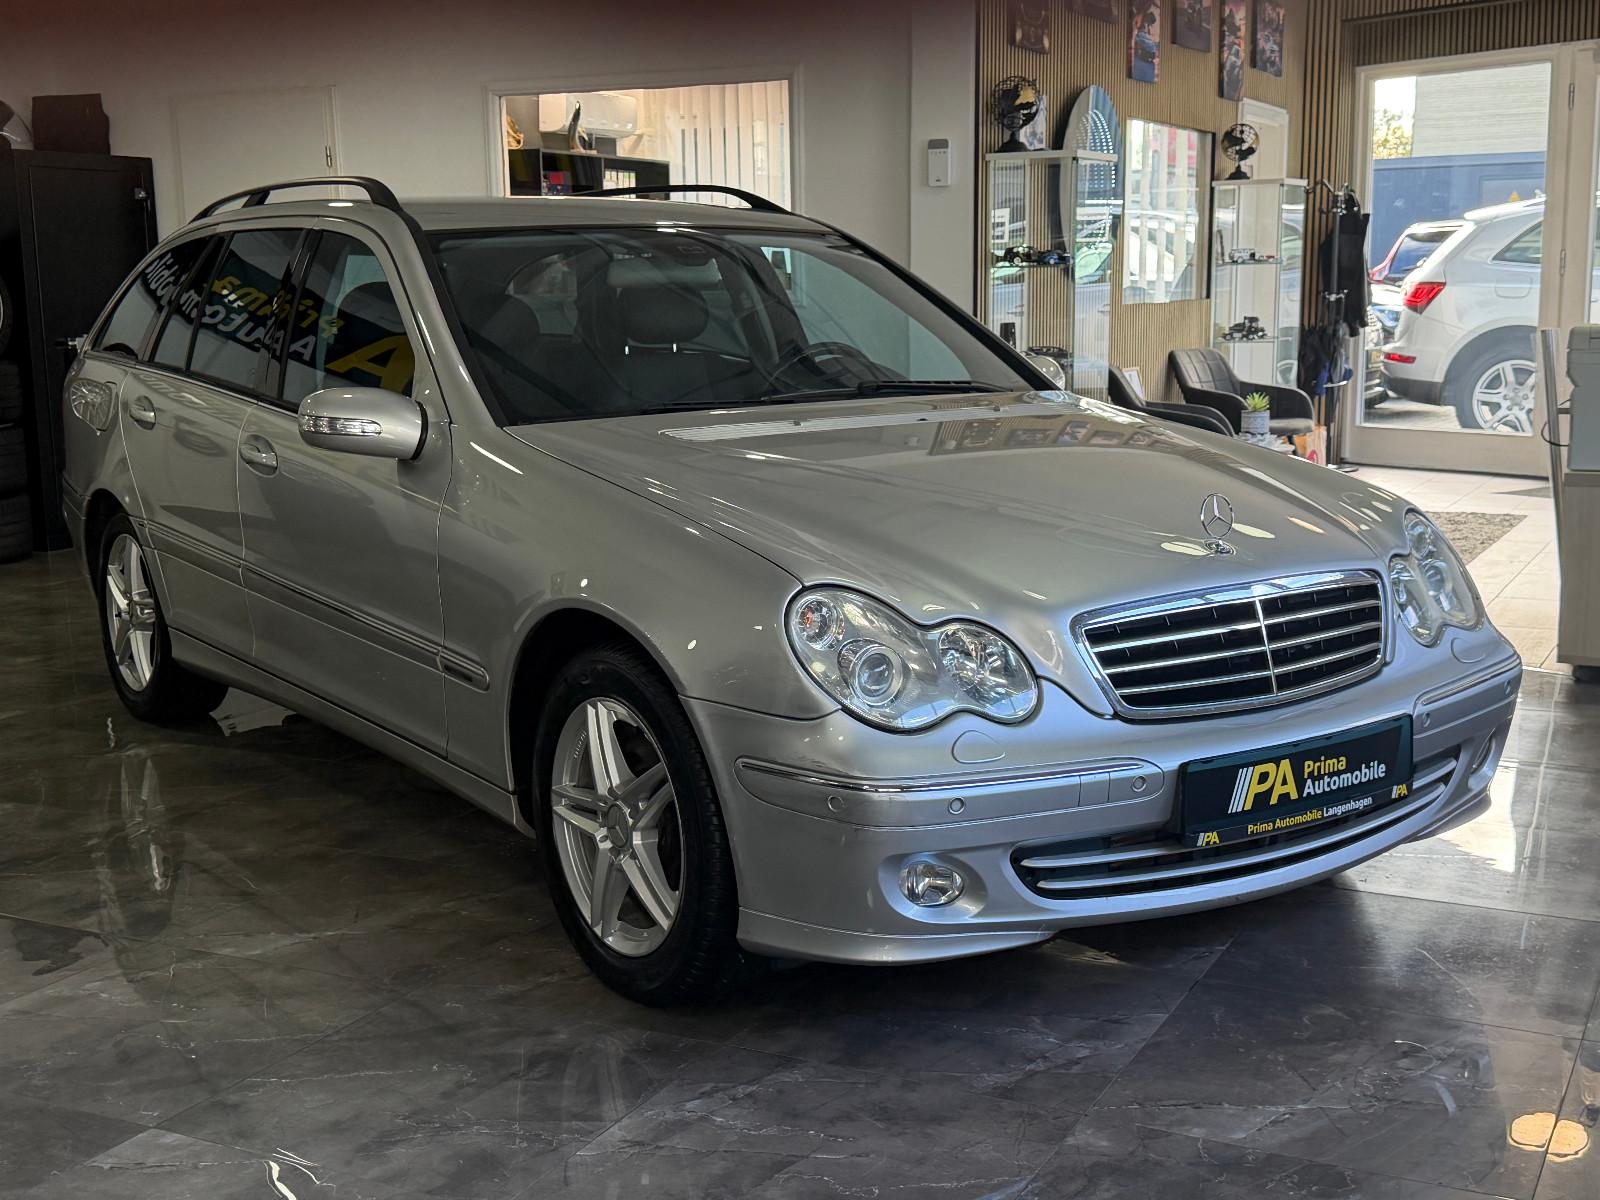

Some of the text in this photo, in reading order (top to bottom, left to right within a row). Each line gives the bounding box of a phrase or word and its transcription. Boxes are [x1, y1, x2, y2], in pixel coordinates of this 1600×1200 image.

[1302, 760, 1386, 797] Automobile
[1303, 755, 1347, 779] Prima
[1394, 783, 1408, 798] PA
[1247, 796, 1373, 835] Prima Automobile Langenhagen
[1202, 831, 1220, 847] PA
